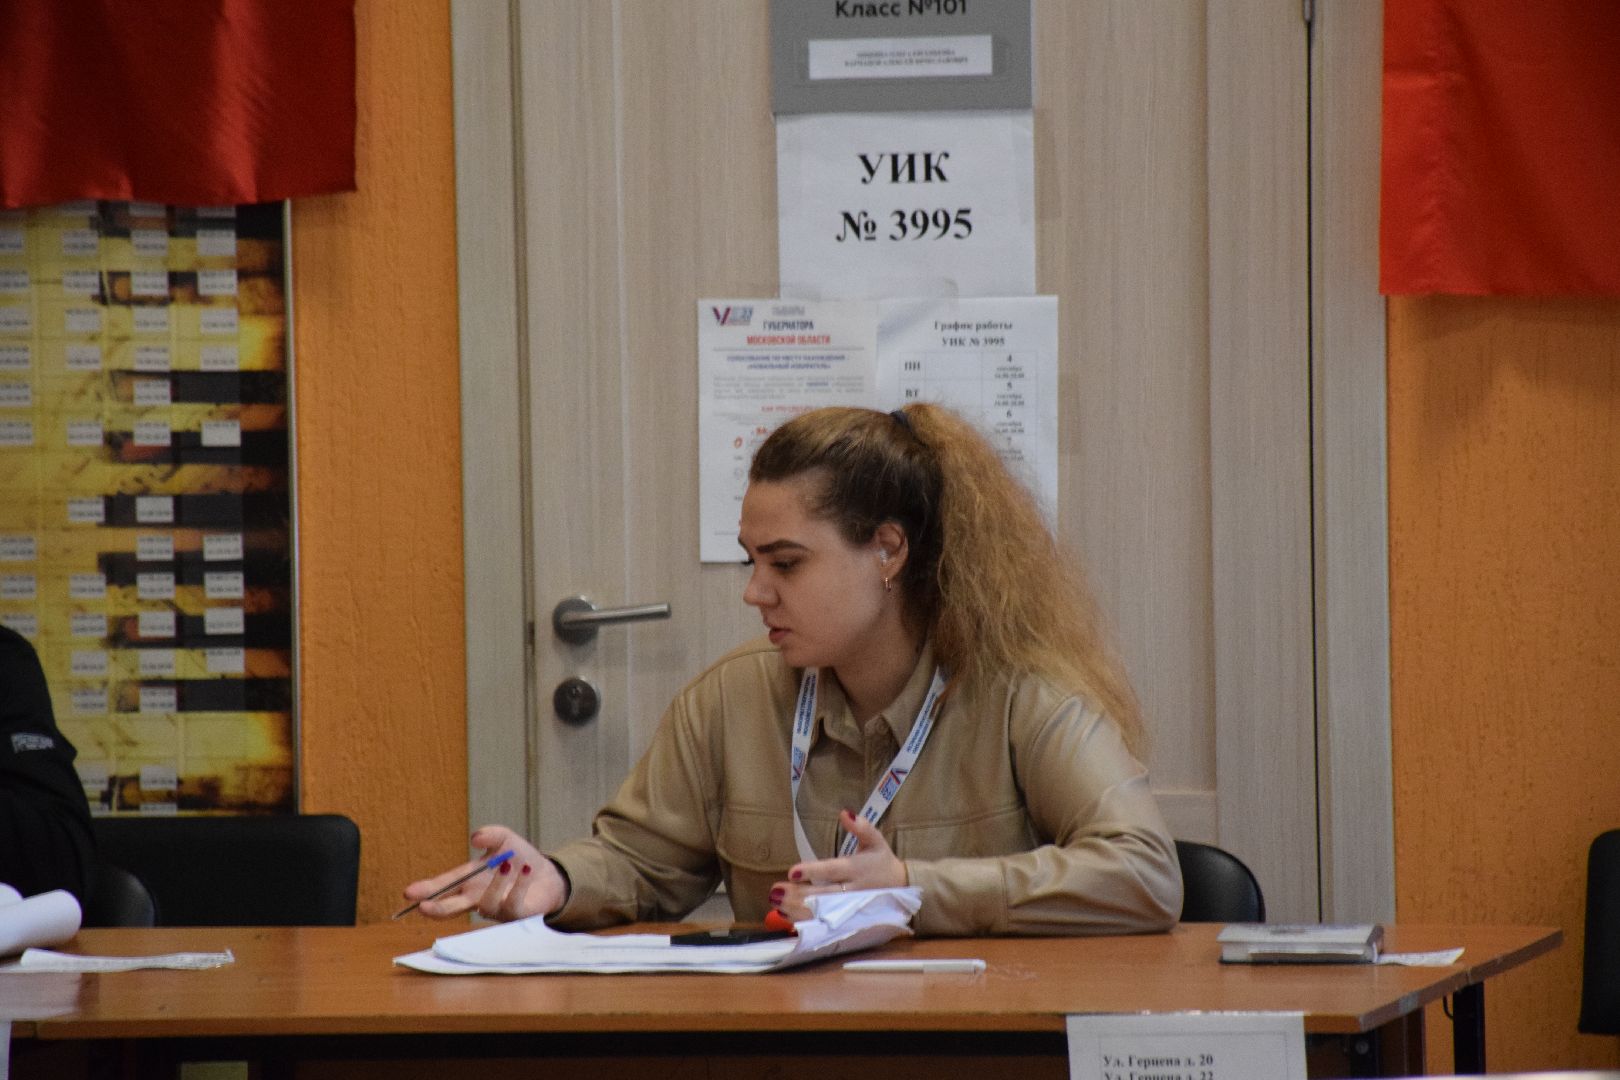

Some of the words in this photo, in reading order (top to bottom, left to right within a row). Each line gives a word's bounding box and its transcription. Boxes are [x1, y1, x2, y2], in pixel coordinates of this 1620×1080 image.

[836, 0, 901, 18] Класс
[858, 151, 950, 184] УИК
[836, 209, 877, 242] №
[889, 208, 973, 241] 3995
[763, 320, 815, 330] ГУБЕРНАТОРА
[934, 320, 973, 332] График
[976, 320, 1013, 332] работы
[942, 337, 966, 347] УИК
[969, 337, 980, 347] №
[982, 337, 1005, 347] 3995
[1006, 354, 1013, 363] 4
[904, 361, 921, 371] ПН
[1103, 1055, 1124, 1067] Ул.
[1128, 1055, 1181, 1069] Герцена
[1200, 1054, 1213, 1065] 20
